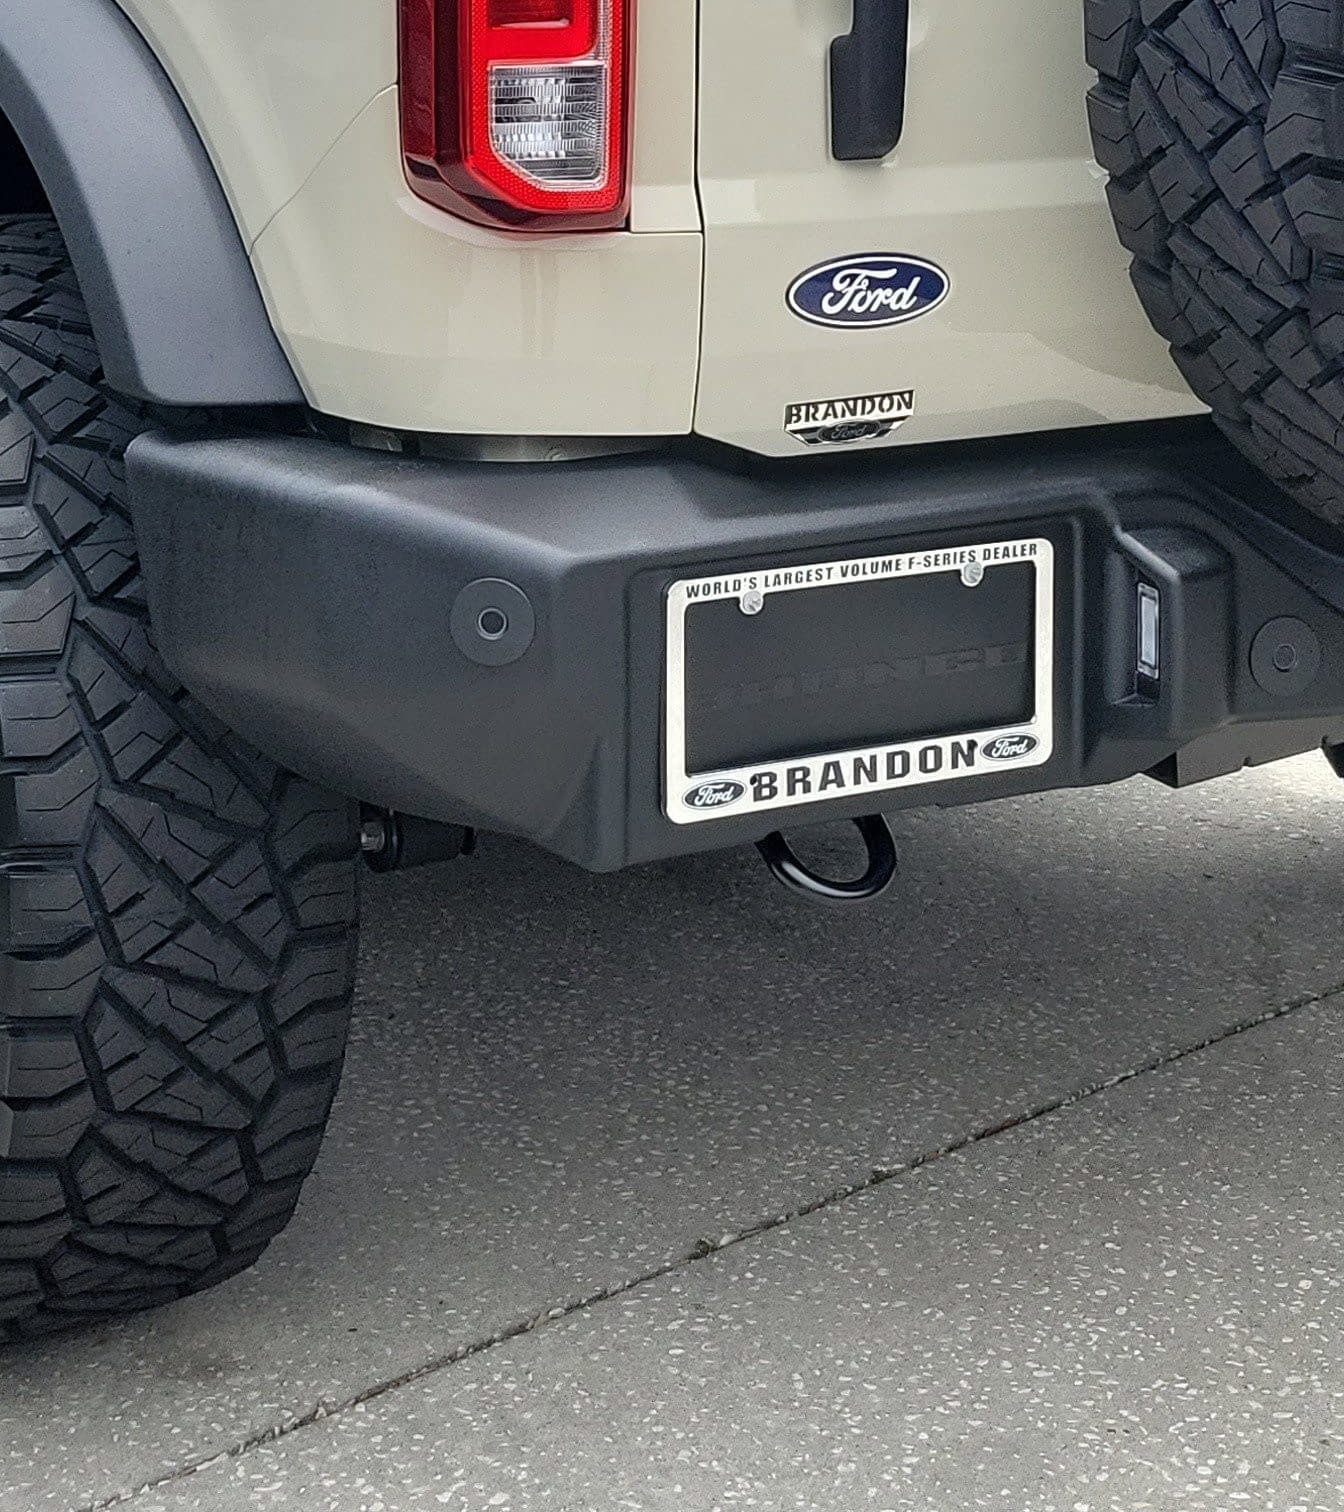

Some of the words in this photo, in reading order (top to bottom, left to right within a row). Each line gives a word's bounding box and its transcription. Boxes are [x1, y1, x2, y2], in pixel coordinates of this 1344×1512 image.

[820, 267, 921, 315] Ford
[787, 391, 914, 425] BRANDON
[686, 575, 758, 599] WORLD'S
[764, 567, 834, 589] LARGEST
[840, 558, 903, 578] VOLUME
[908, 549, 977, 570] F-SERIES
[983, 542, 1038, 561] DEALER
[691, 782, 742, 805] Ford
[750, 739, 978, 803] BRANDON
